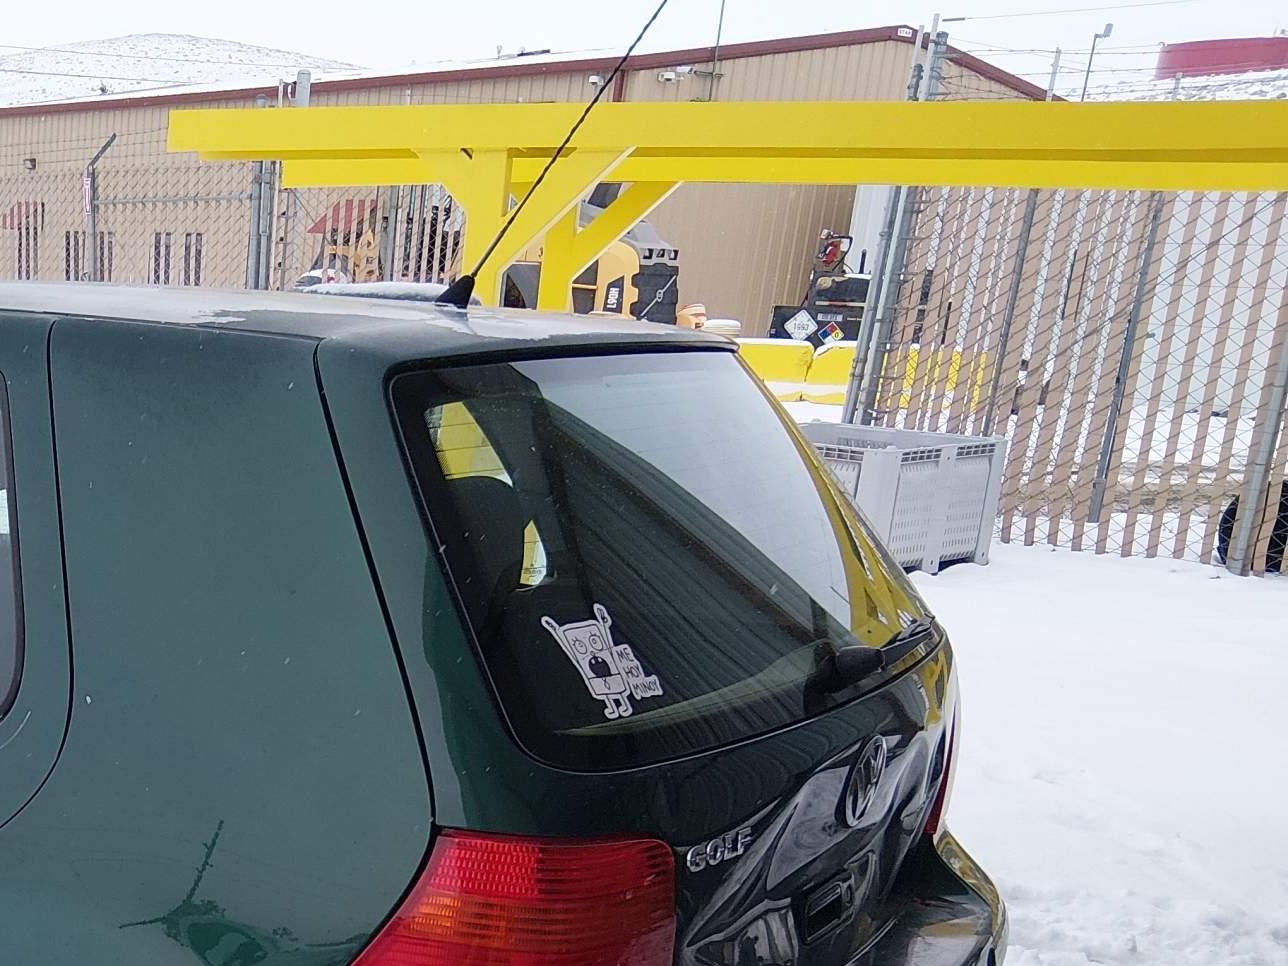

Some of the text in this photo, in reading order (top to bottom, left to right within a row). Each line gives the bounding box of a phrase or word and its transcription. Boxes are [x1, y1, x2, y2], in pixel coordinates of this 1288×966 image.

[606, 287, 620, 308] L90H
[615, 647, 634, 662] ME
[623, 664, 643, 679] HOY
[632, 680, 660, 696] MINOY
[686, 826, 753, 873] GOLF
